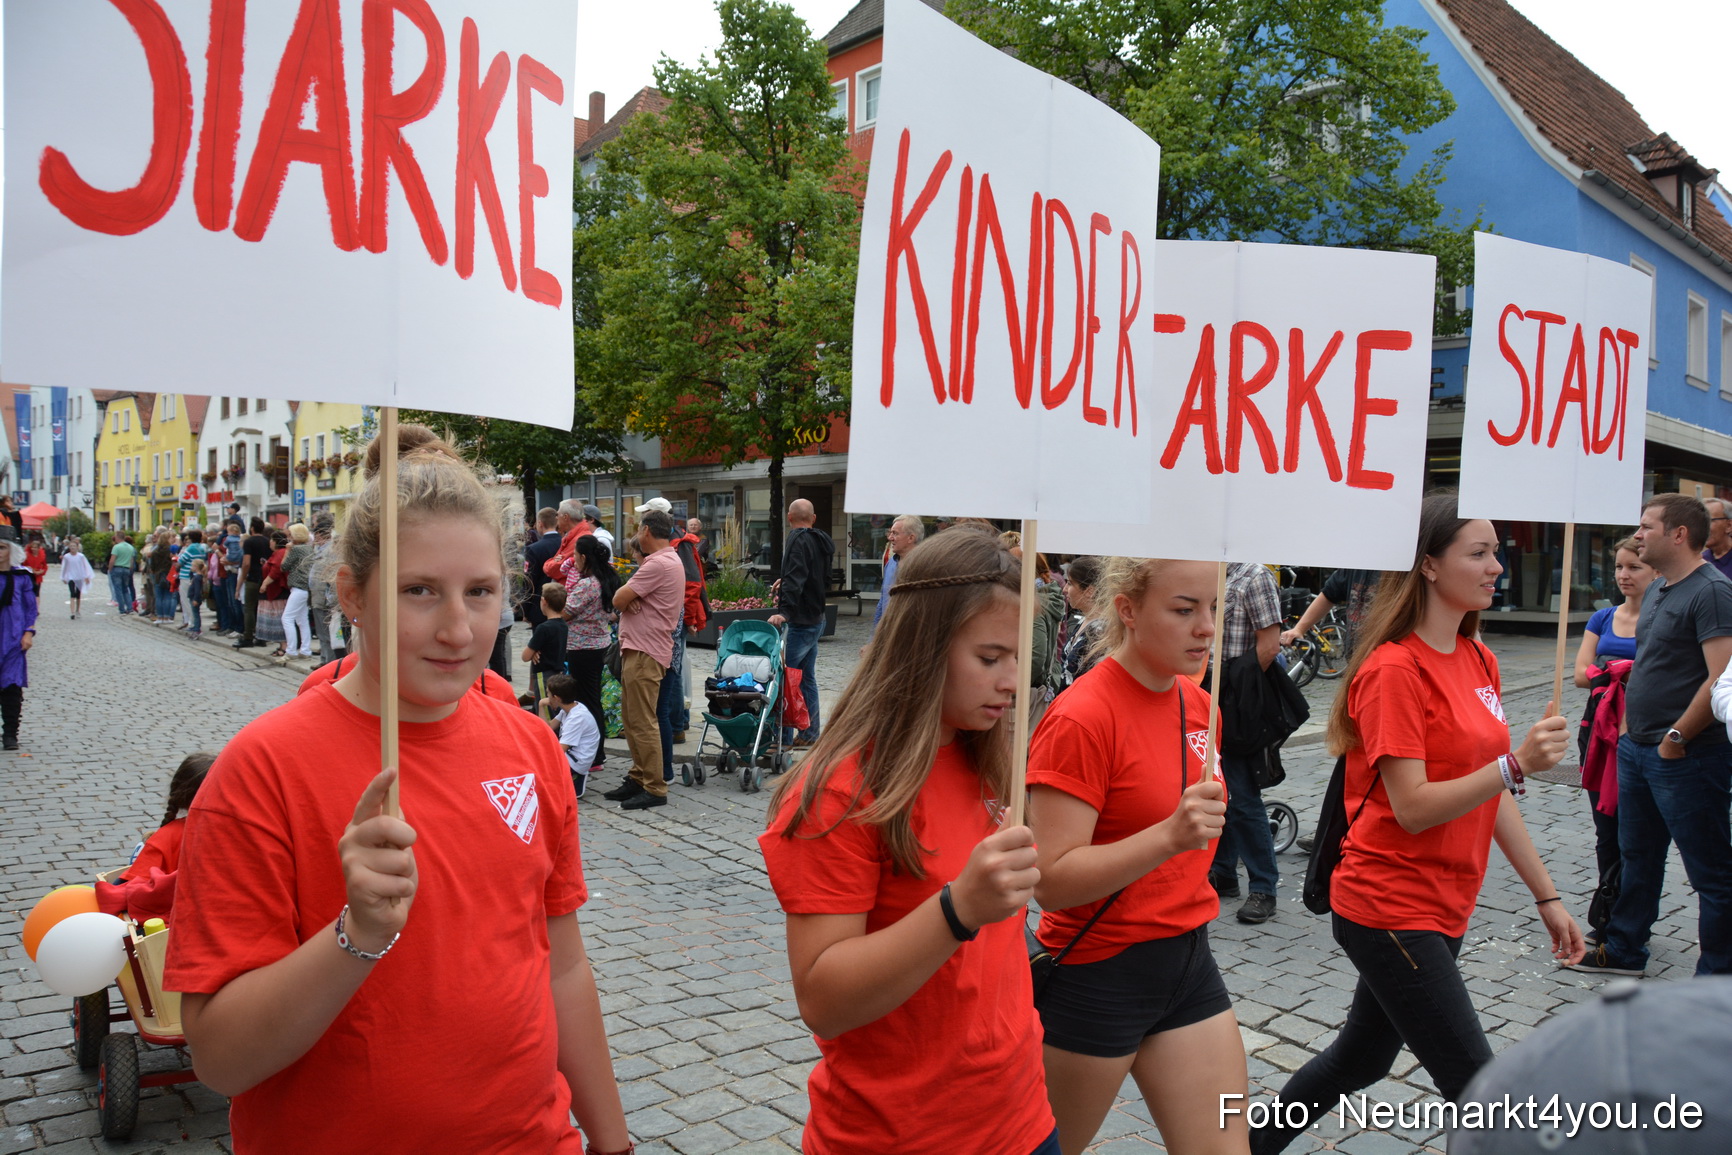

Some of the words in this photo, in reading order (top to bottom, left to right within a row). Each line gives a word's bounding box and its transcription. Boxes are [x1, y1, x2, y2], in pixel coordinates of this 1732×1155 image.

[880, 127, 1142, 437] KINDER
[1154, 313, 1413, 490] ARKE
[1487, 303, 1640, 461] STADT
[295, 491, 303, 503] P
